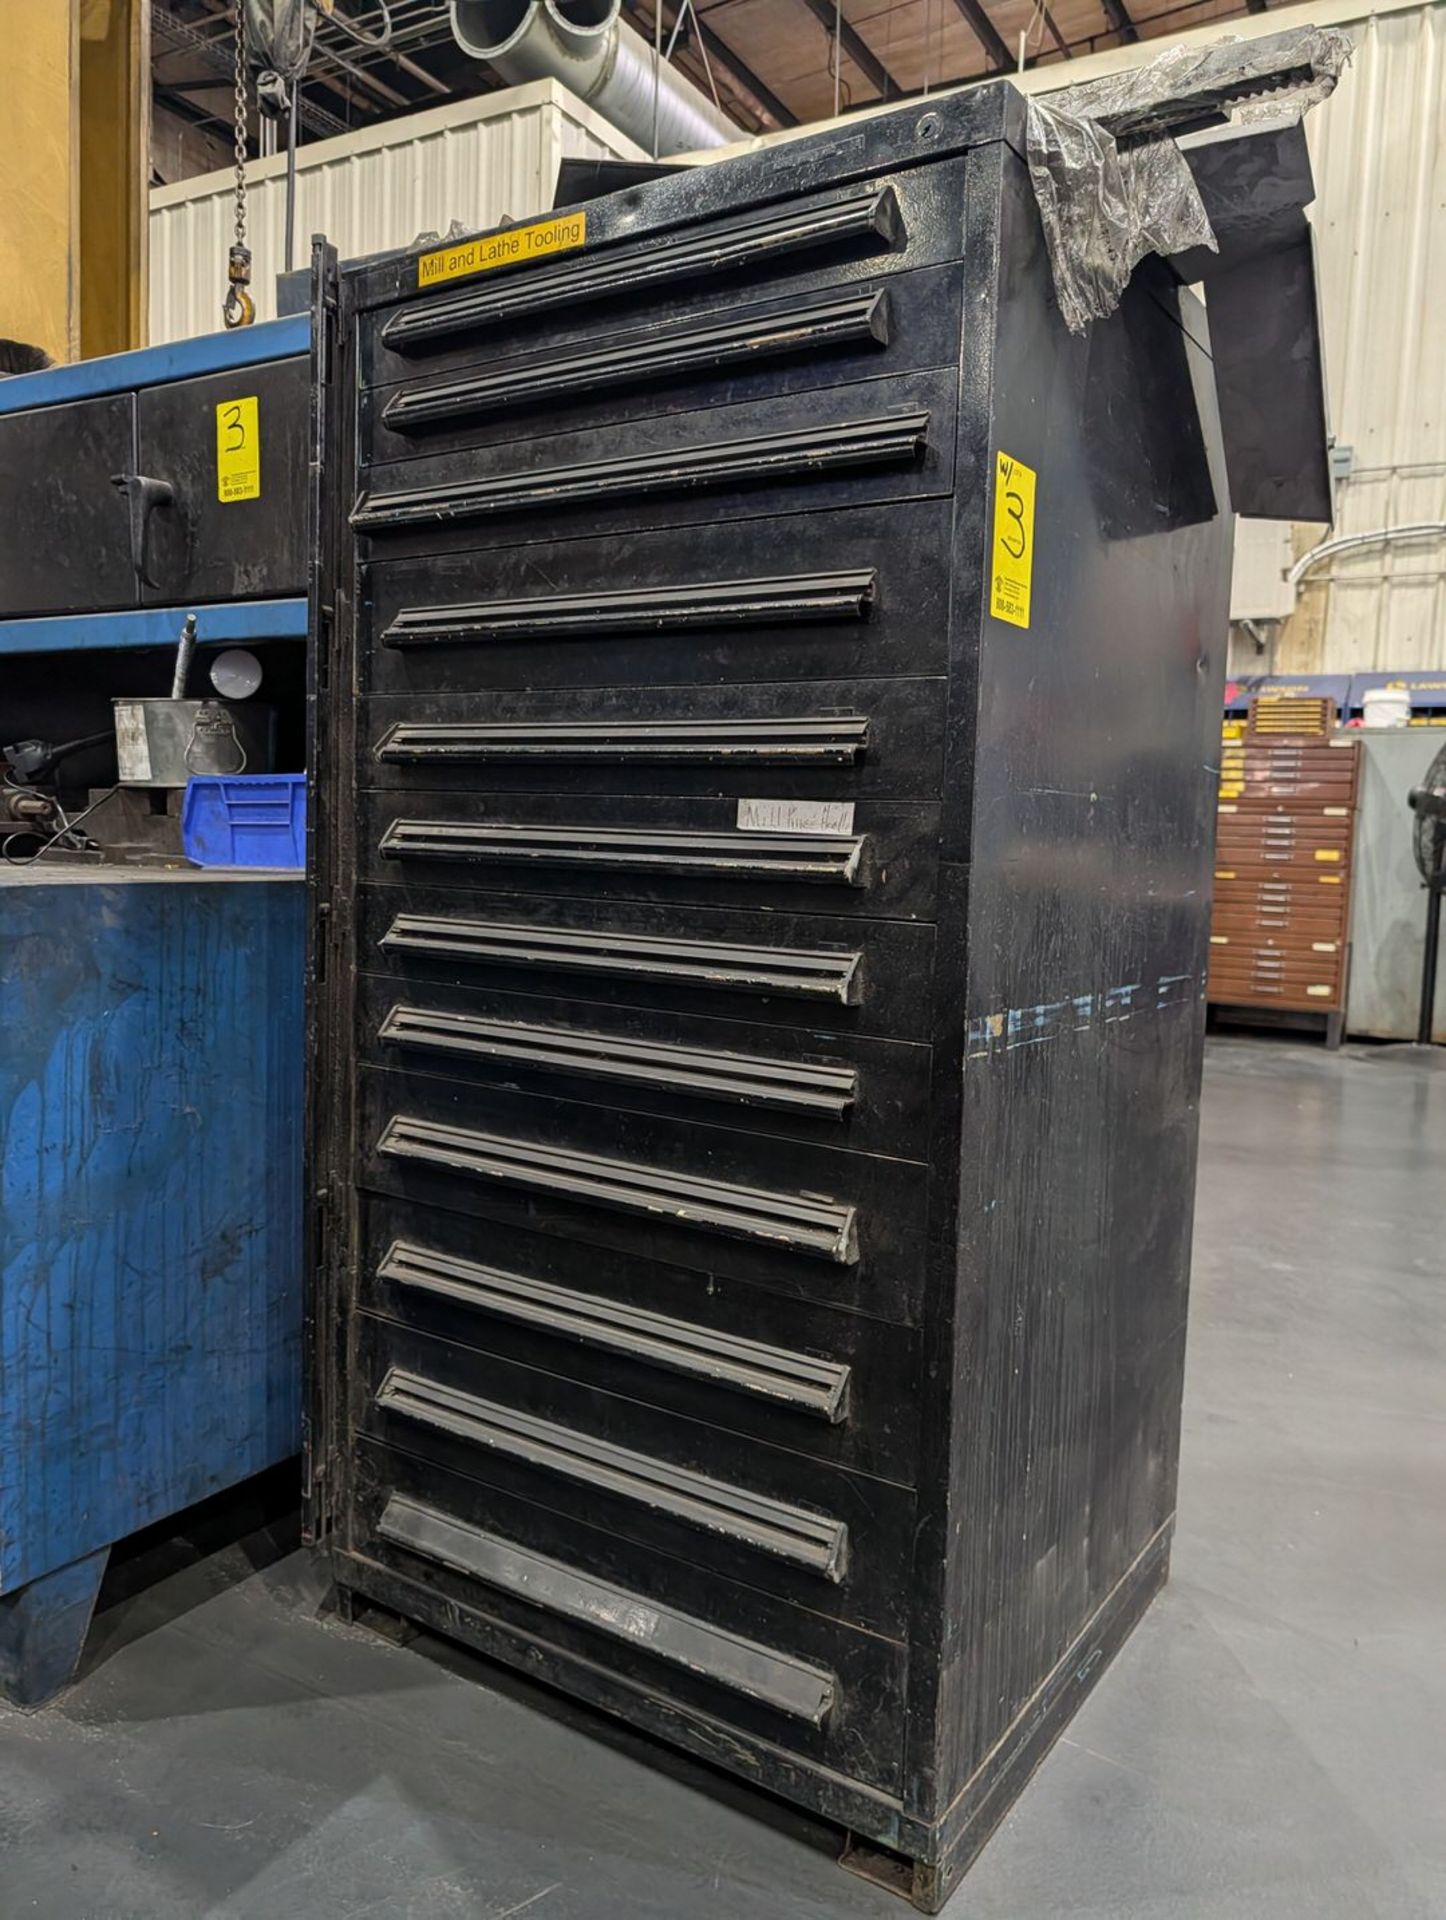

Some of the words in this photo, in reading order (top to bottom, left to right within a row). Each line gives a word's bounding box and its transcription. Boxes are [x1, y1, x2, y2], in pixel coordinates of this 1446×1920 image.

[422, 256, 445, 279] Mill
[449, 248, 474, 272] and
[479, 239, 520, 263] Lathe
[525, 223, 580, 249] Tooling
[223, 405, 246, 453] 3
[1001, 491, 1026, 559] 3
